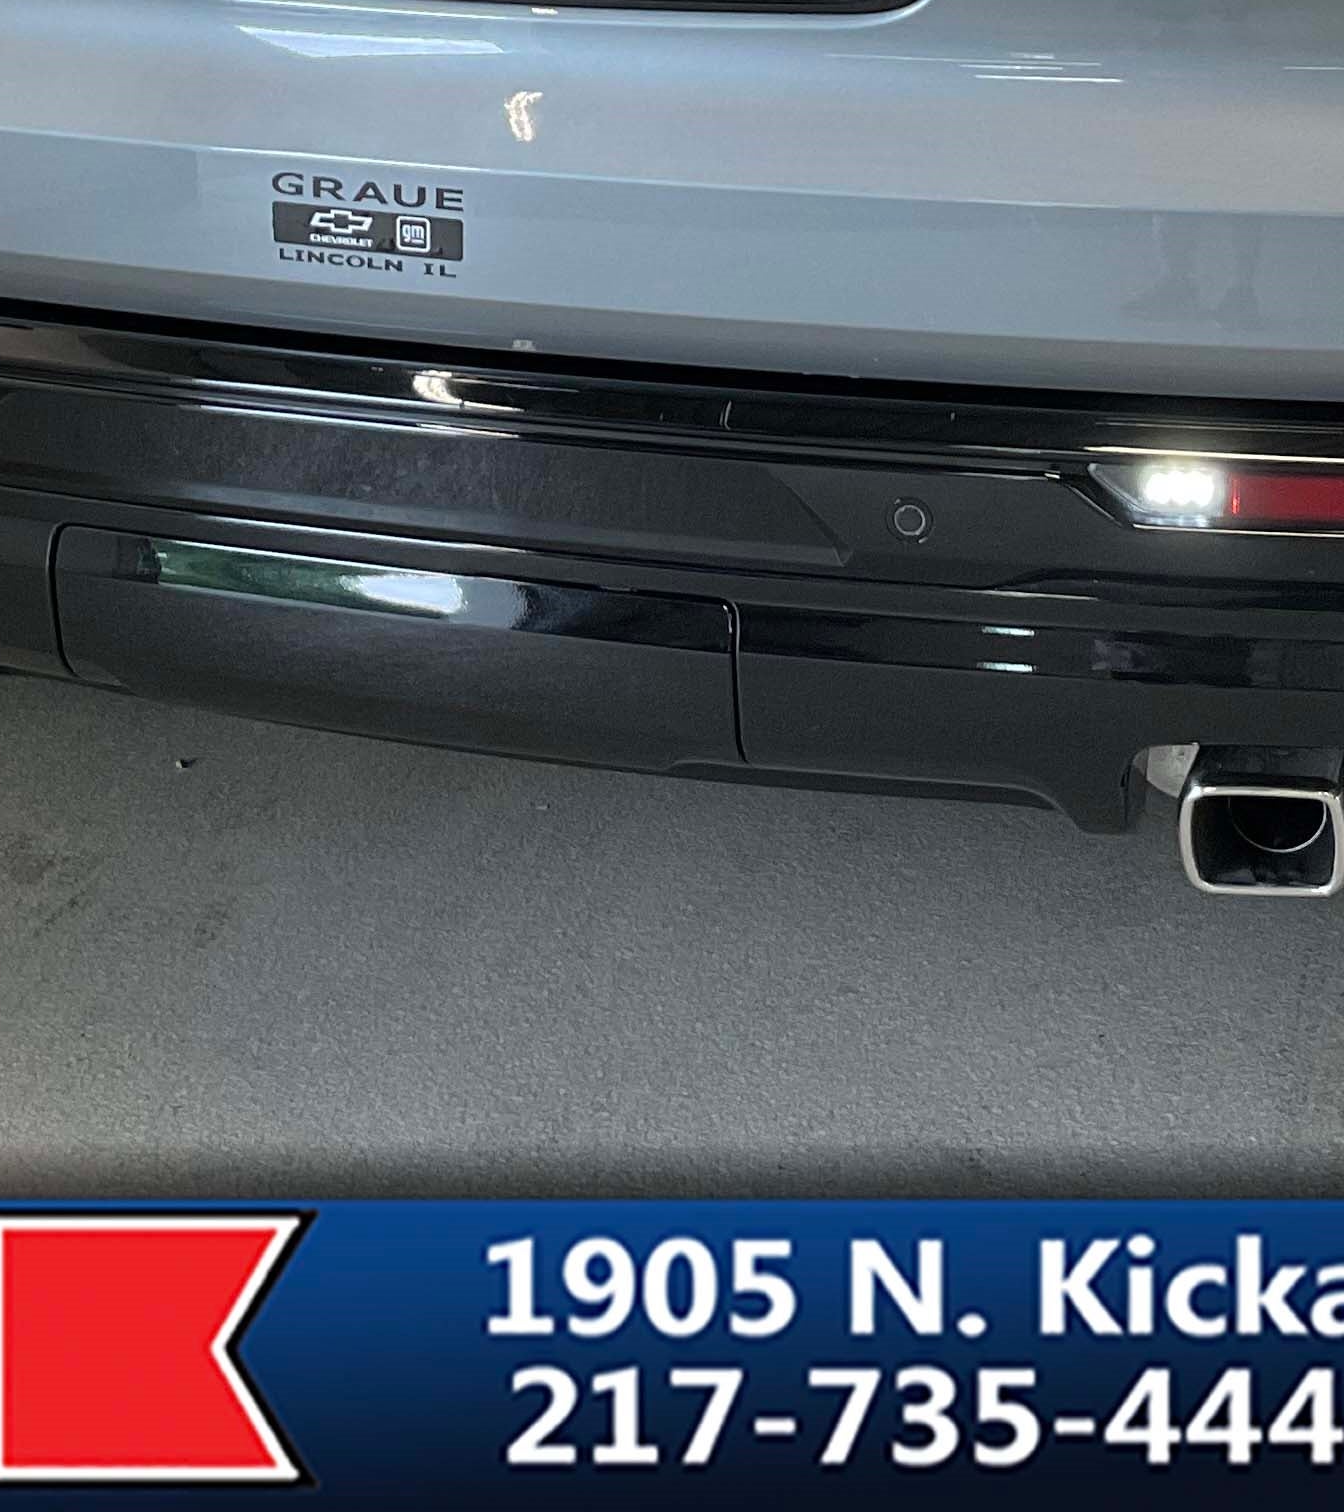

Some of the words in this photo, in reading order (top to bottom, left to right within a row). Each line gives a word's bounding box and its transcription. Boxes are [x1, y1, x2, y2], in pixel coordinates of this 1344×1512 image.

[271, 172, 464, 212] GRAUE
[309, 233, 374, 248] CHEVROLET
[401, 223, 425, 244] gm
[279, 247, 404, 272] LINCOLN
[423, 262, 457, 278] IL
